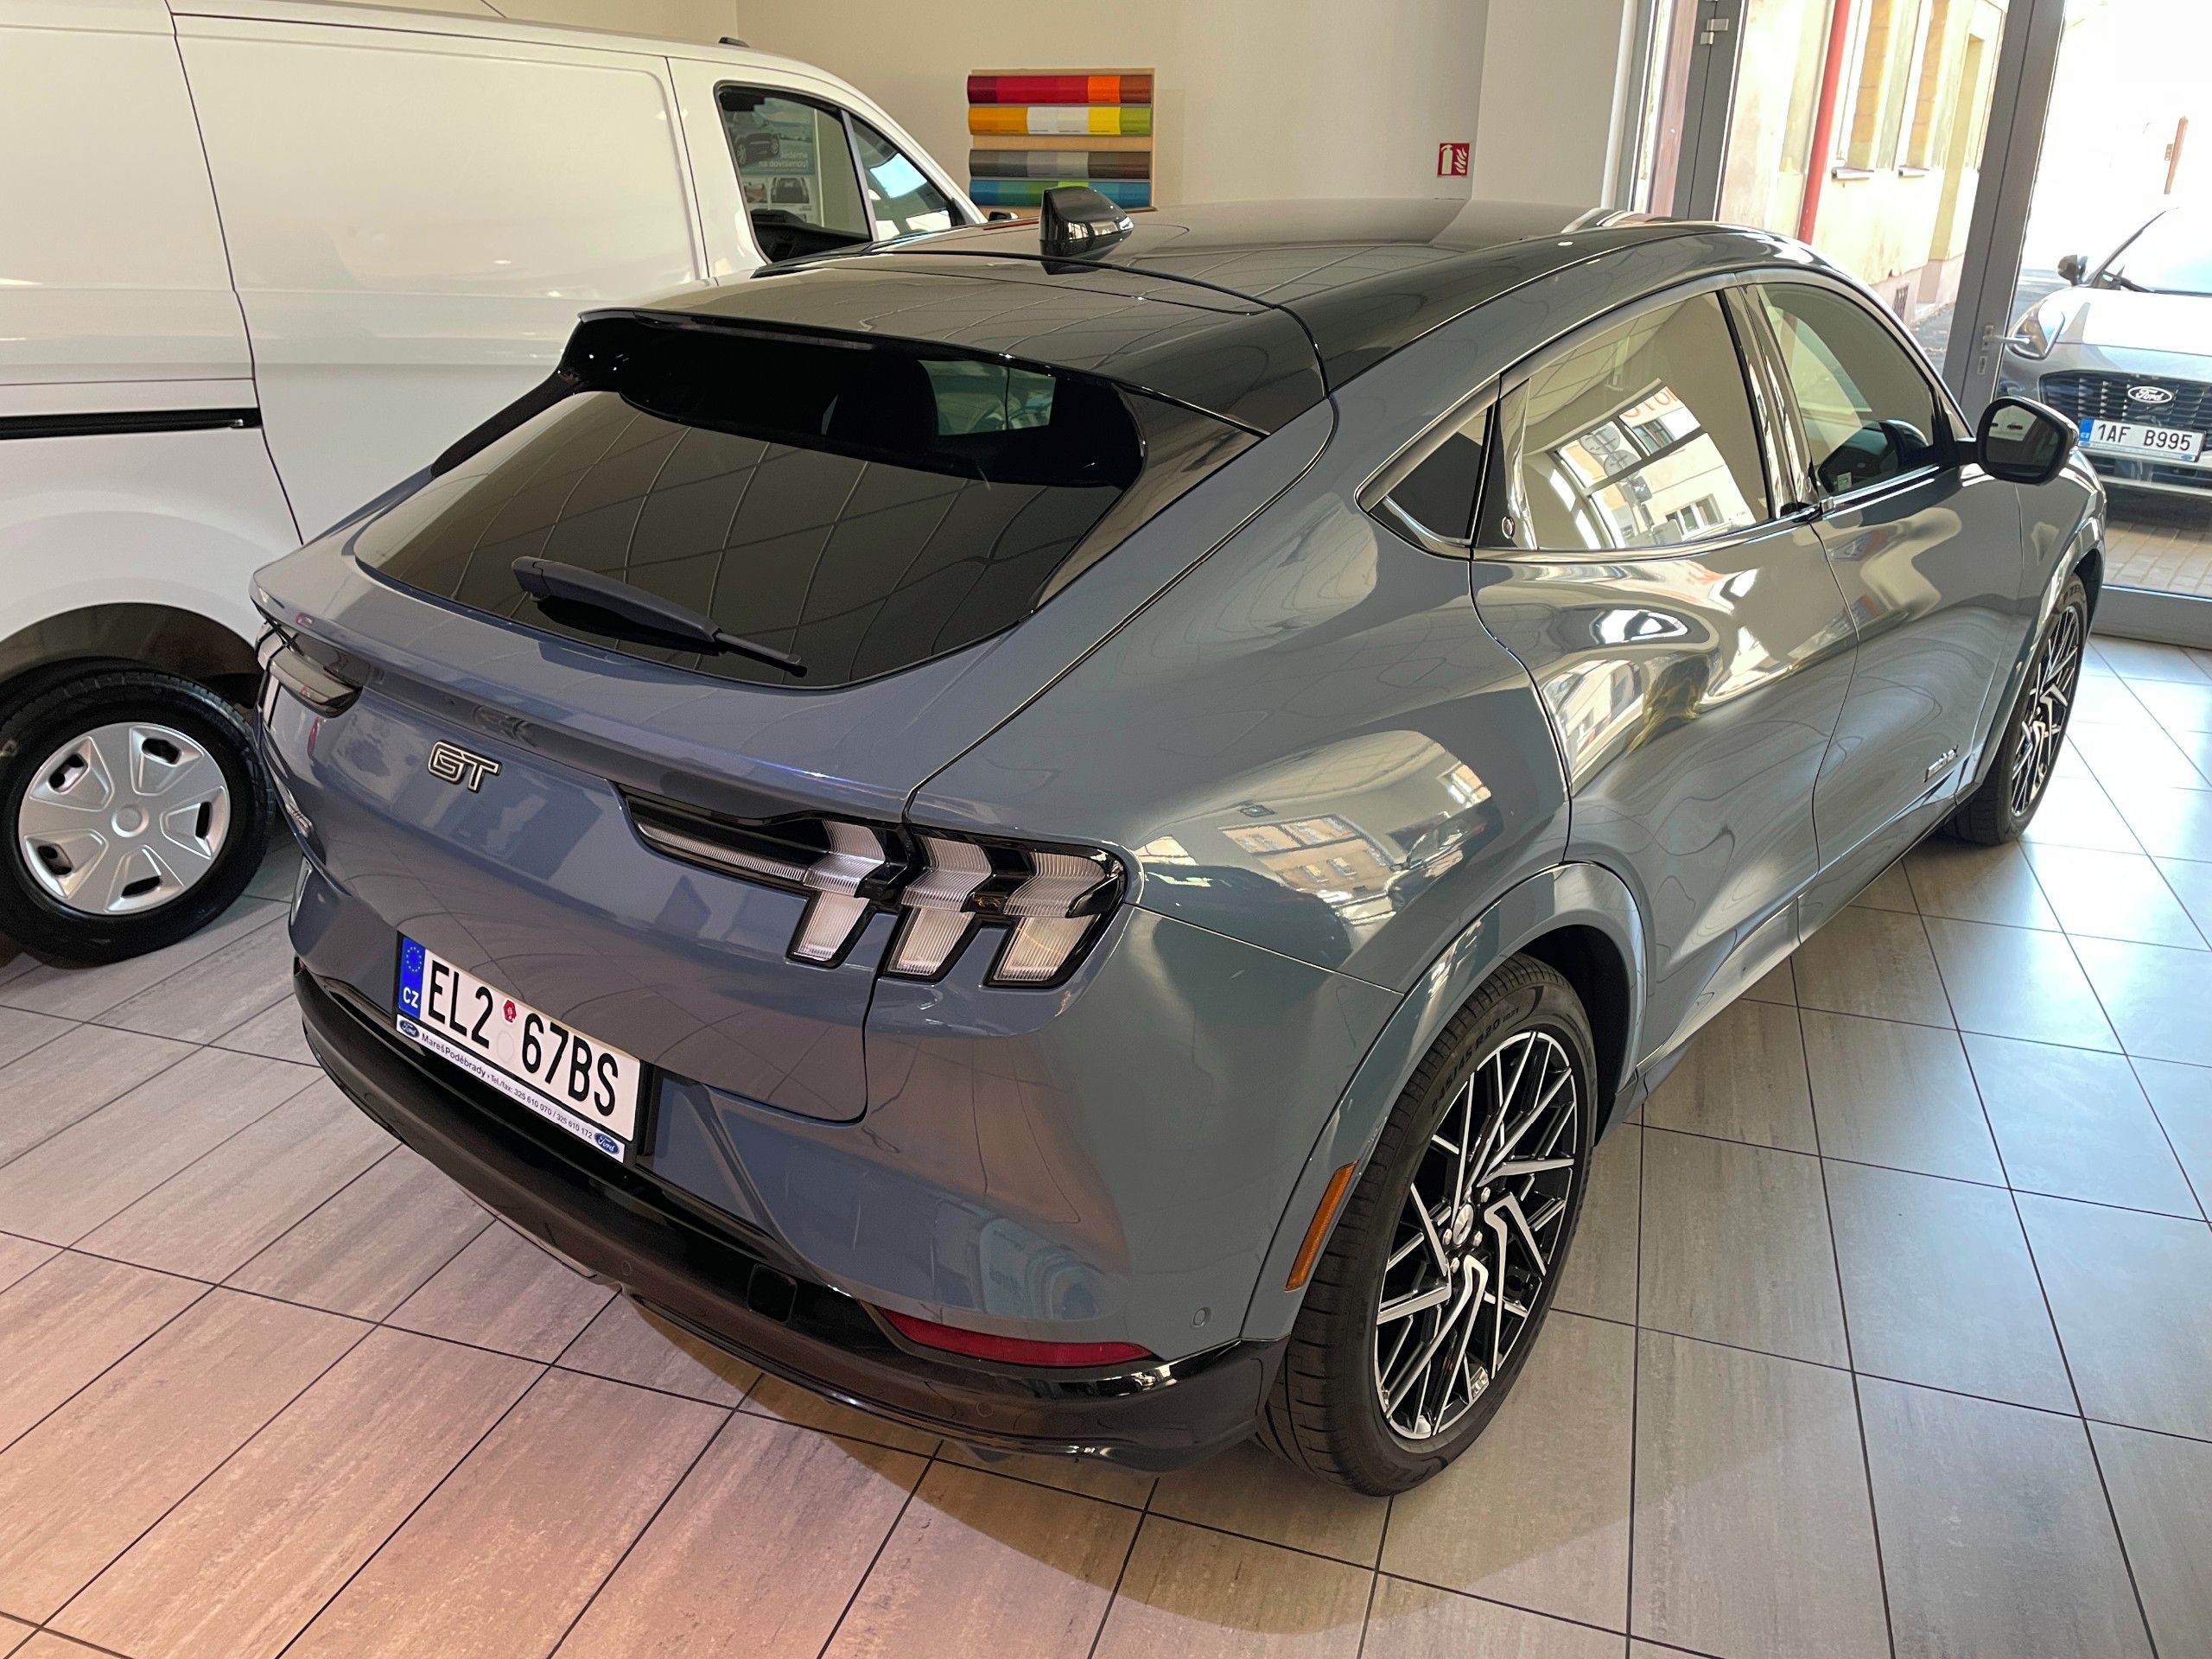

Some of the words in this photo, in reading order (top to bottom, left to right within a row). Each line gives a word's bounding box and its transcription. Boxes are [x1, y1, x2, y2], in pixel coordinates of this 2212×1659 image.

[2133, 387, 2168, 403] Ford
[2098, 423, 2132, 443] 1AF
[2143, 429, 2193, 451] B995
[428, 740, 502, 793] GT
[403, 987, 419, 1009] CZ
[401, 1021, 417, 1036] Ford
[428, 959, 493, 1049] EL2
[521, 1012, 619, 1117] 67BS
[1476, 1018, 1501, 1051] R20
[596, 1134, 616, 1153] Ford
